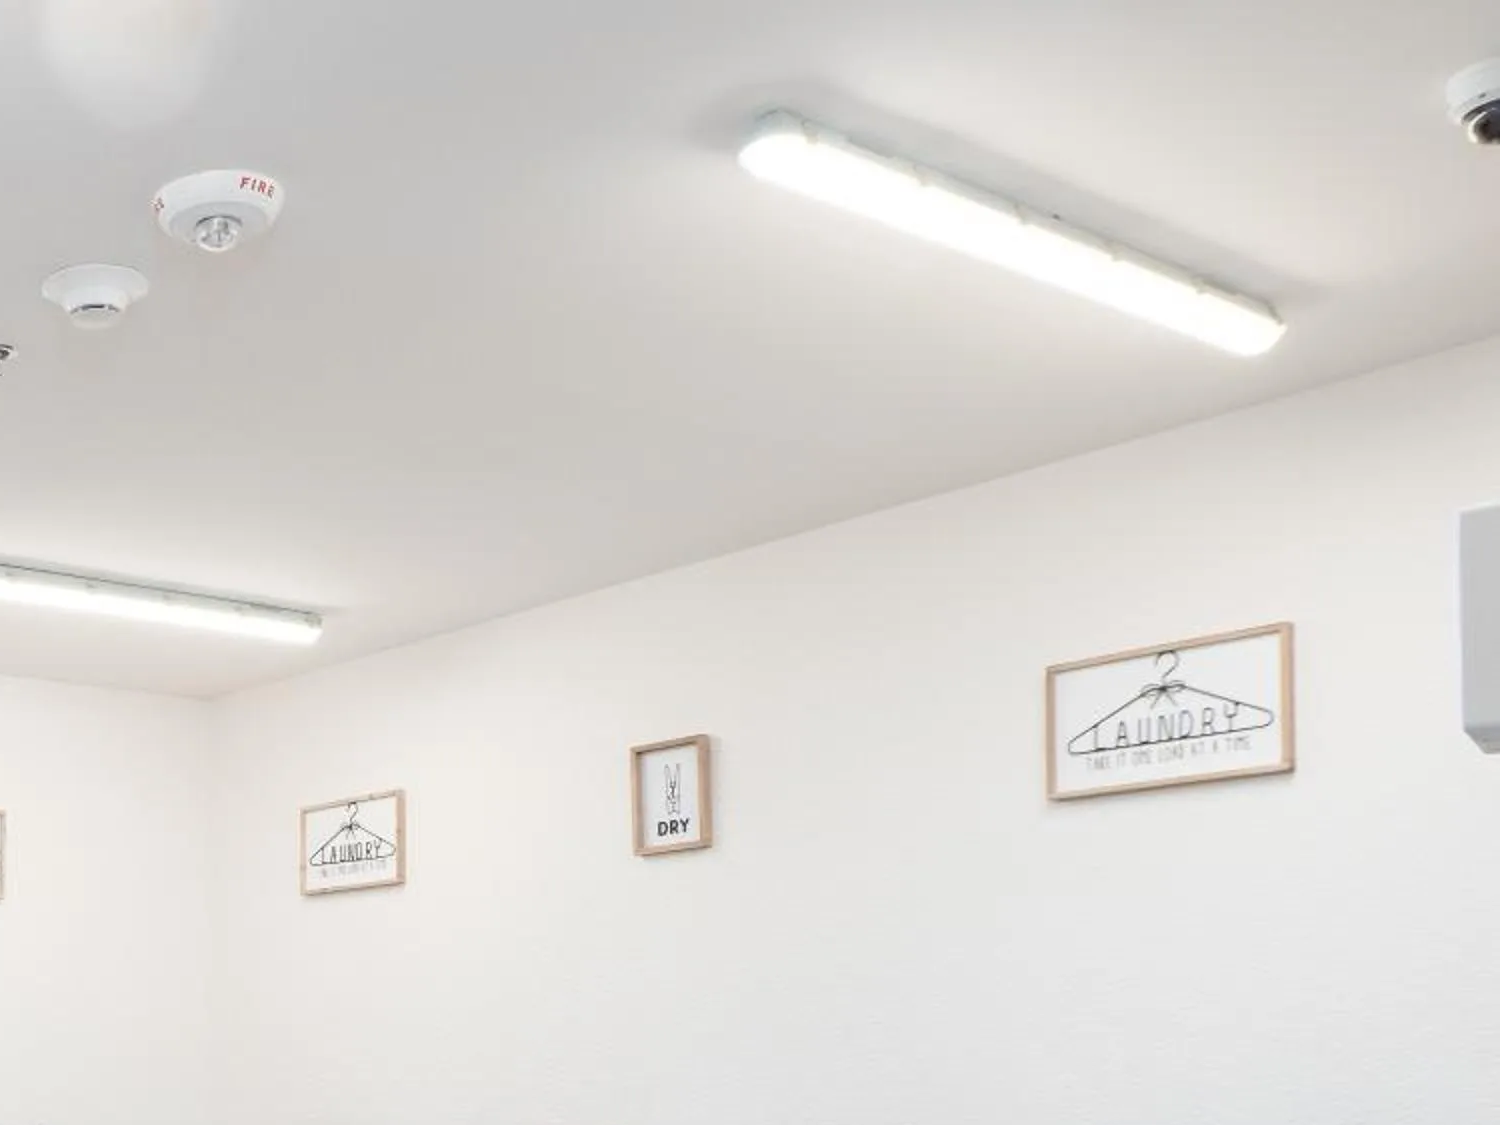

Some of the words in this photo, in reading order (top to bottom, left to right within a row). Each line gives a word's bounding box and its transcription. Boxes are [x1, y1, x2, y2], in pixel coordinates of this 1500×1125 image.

[240, 176, 275, 199] FIRE
[1092, 702, 1240, 751] LAUNDRY
[657, 817, 690, 837] DRY
[321, 839, 381, 864] LAUNDRY
